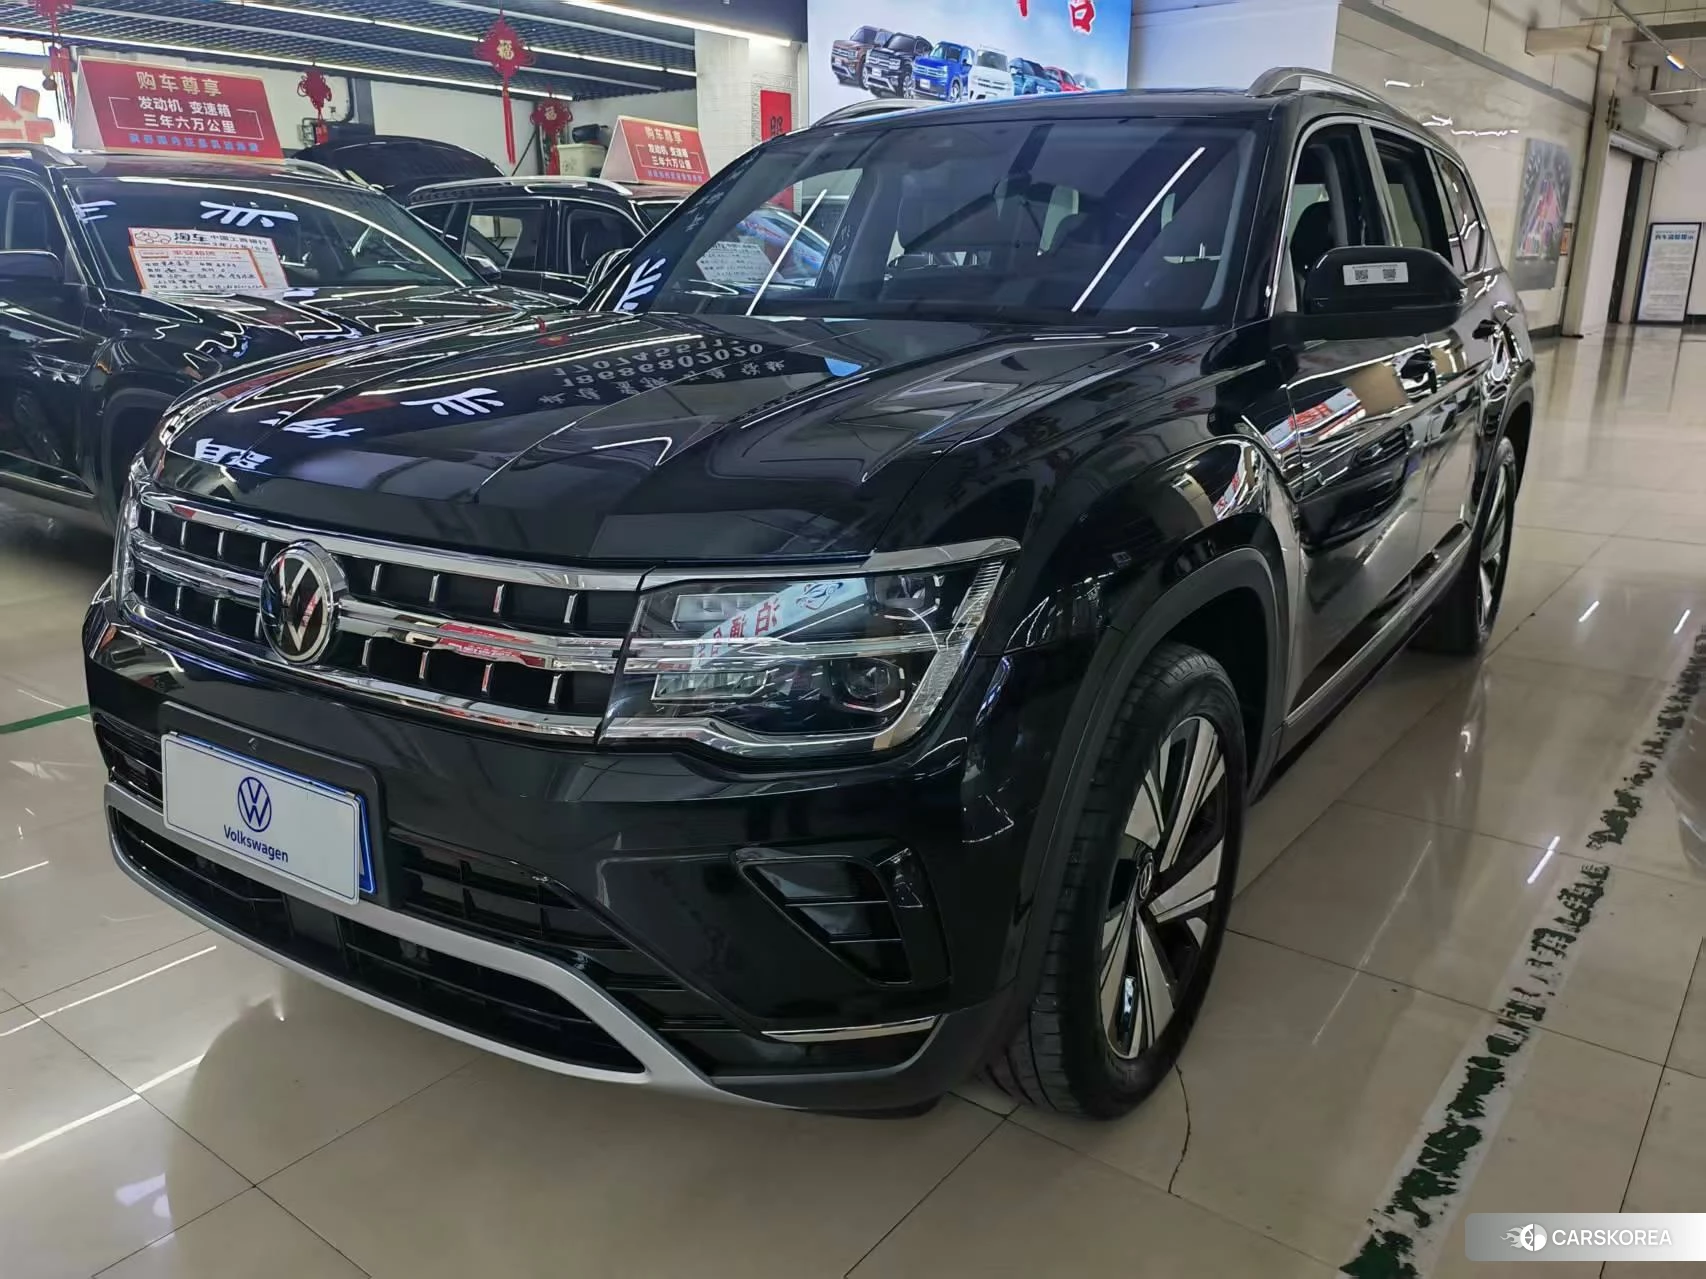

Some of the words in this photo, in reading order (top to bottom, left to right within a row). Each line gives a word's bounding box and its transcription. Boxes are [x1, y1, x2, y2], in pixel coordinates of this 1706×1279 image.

[136, 71, 222, 97] 购车尊享
[138, 95, 184, 113] 发动机
[188, 101, 232, 118] 变速箱
[143, 113, 238, 134] 三年六万公里
[223, 824, 289, 863] Volkswagen
